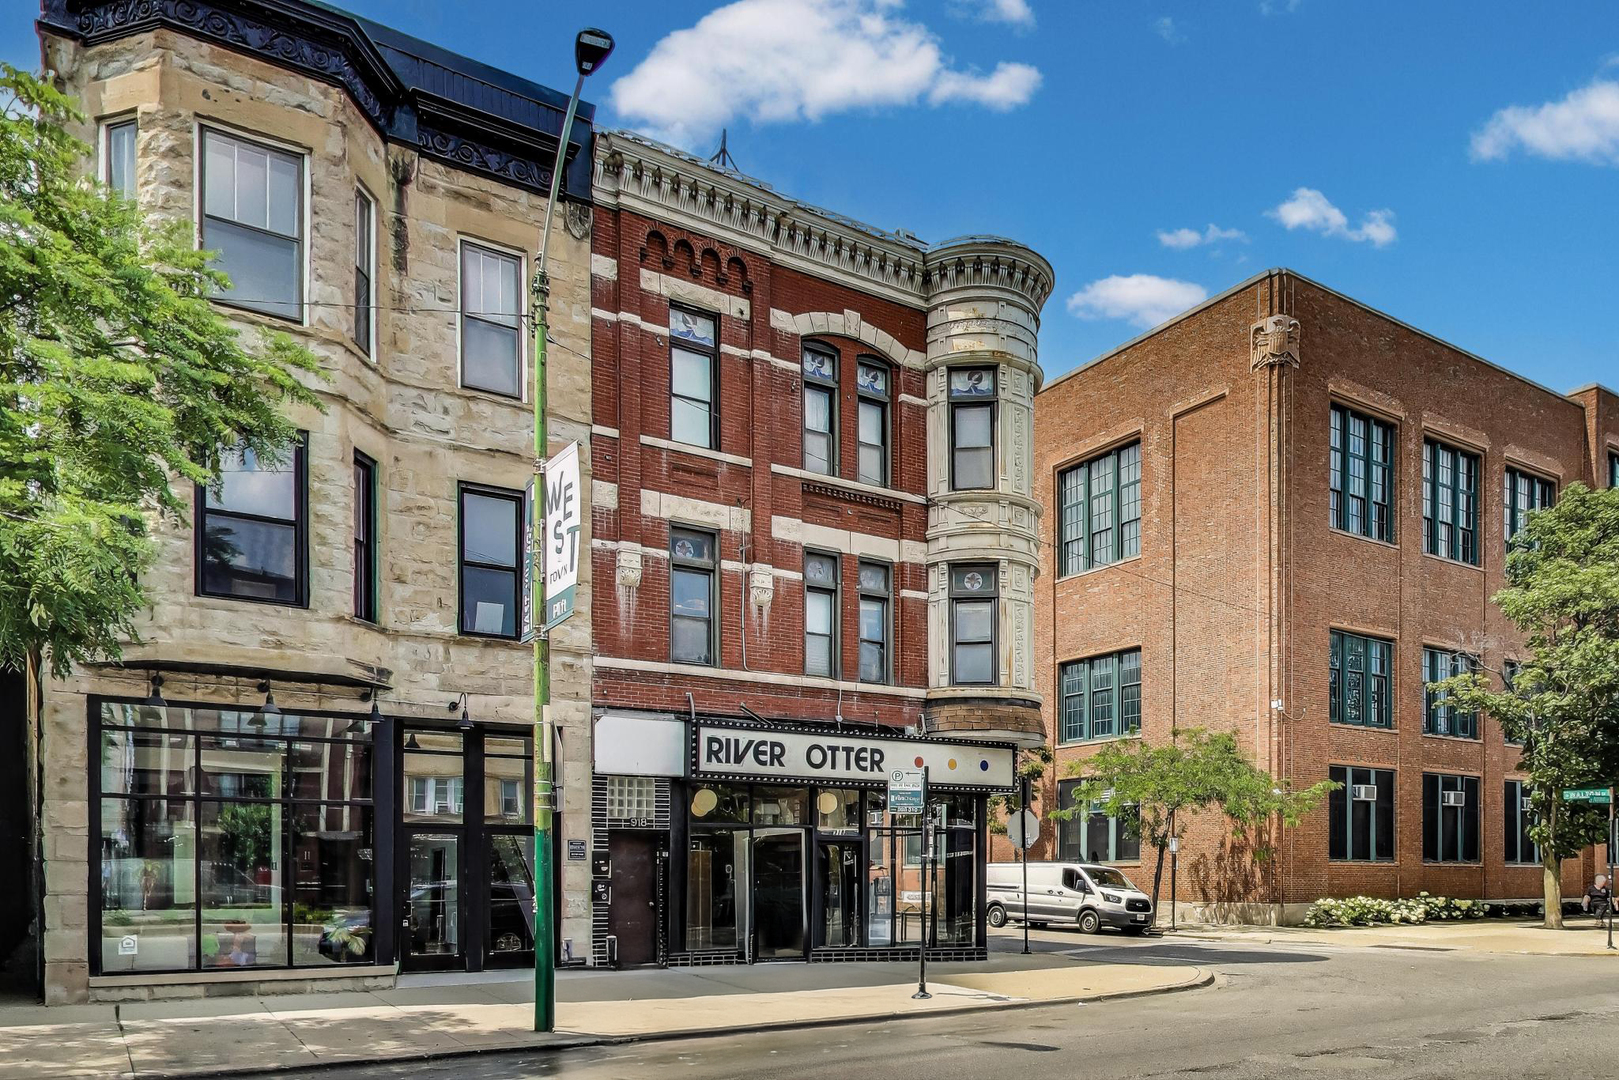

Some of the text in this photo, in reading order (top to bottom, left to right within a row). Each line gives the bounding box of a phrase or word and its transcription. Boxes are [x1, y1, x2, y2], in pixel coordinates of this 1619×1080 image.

[706, 737, 884, 773] RIVER OTTER
[630, 818, 647, 827] 918
